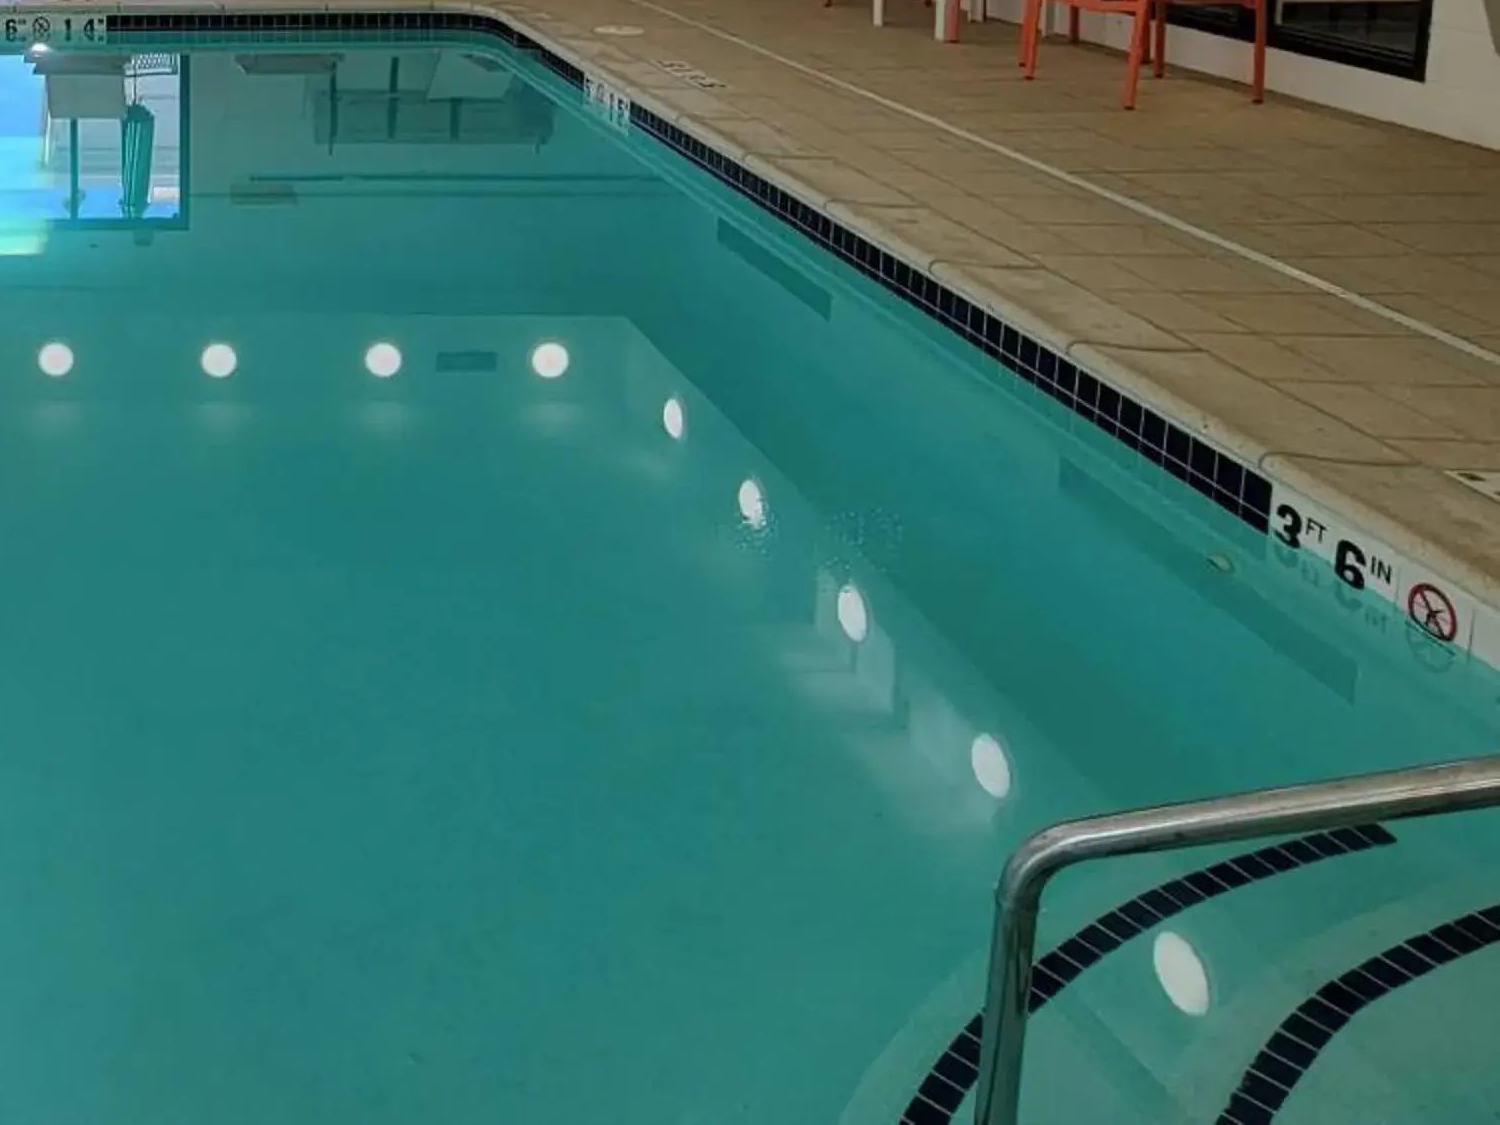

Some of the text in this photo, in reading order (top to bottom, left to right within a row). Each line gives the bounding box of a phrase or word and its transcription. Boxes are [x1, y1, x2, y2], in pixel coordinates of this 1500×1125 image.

[5, 18, 18, 34] 6
[1274, 504, 1393, 590] 3 FT 6 IN
